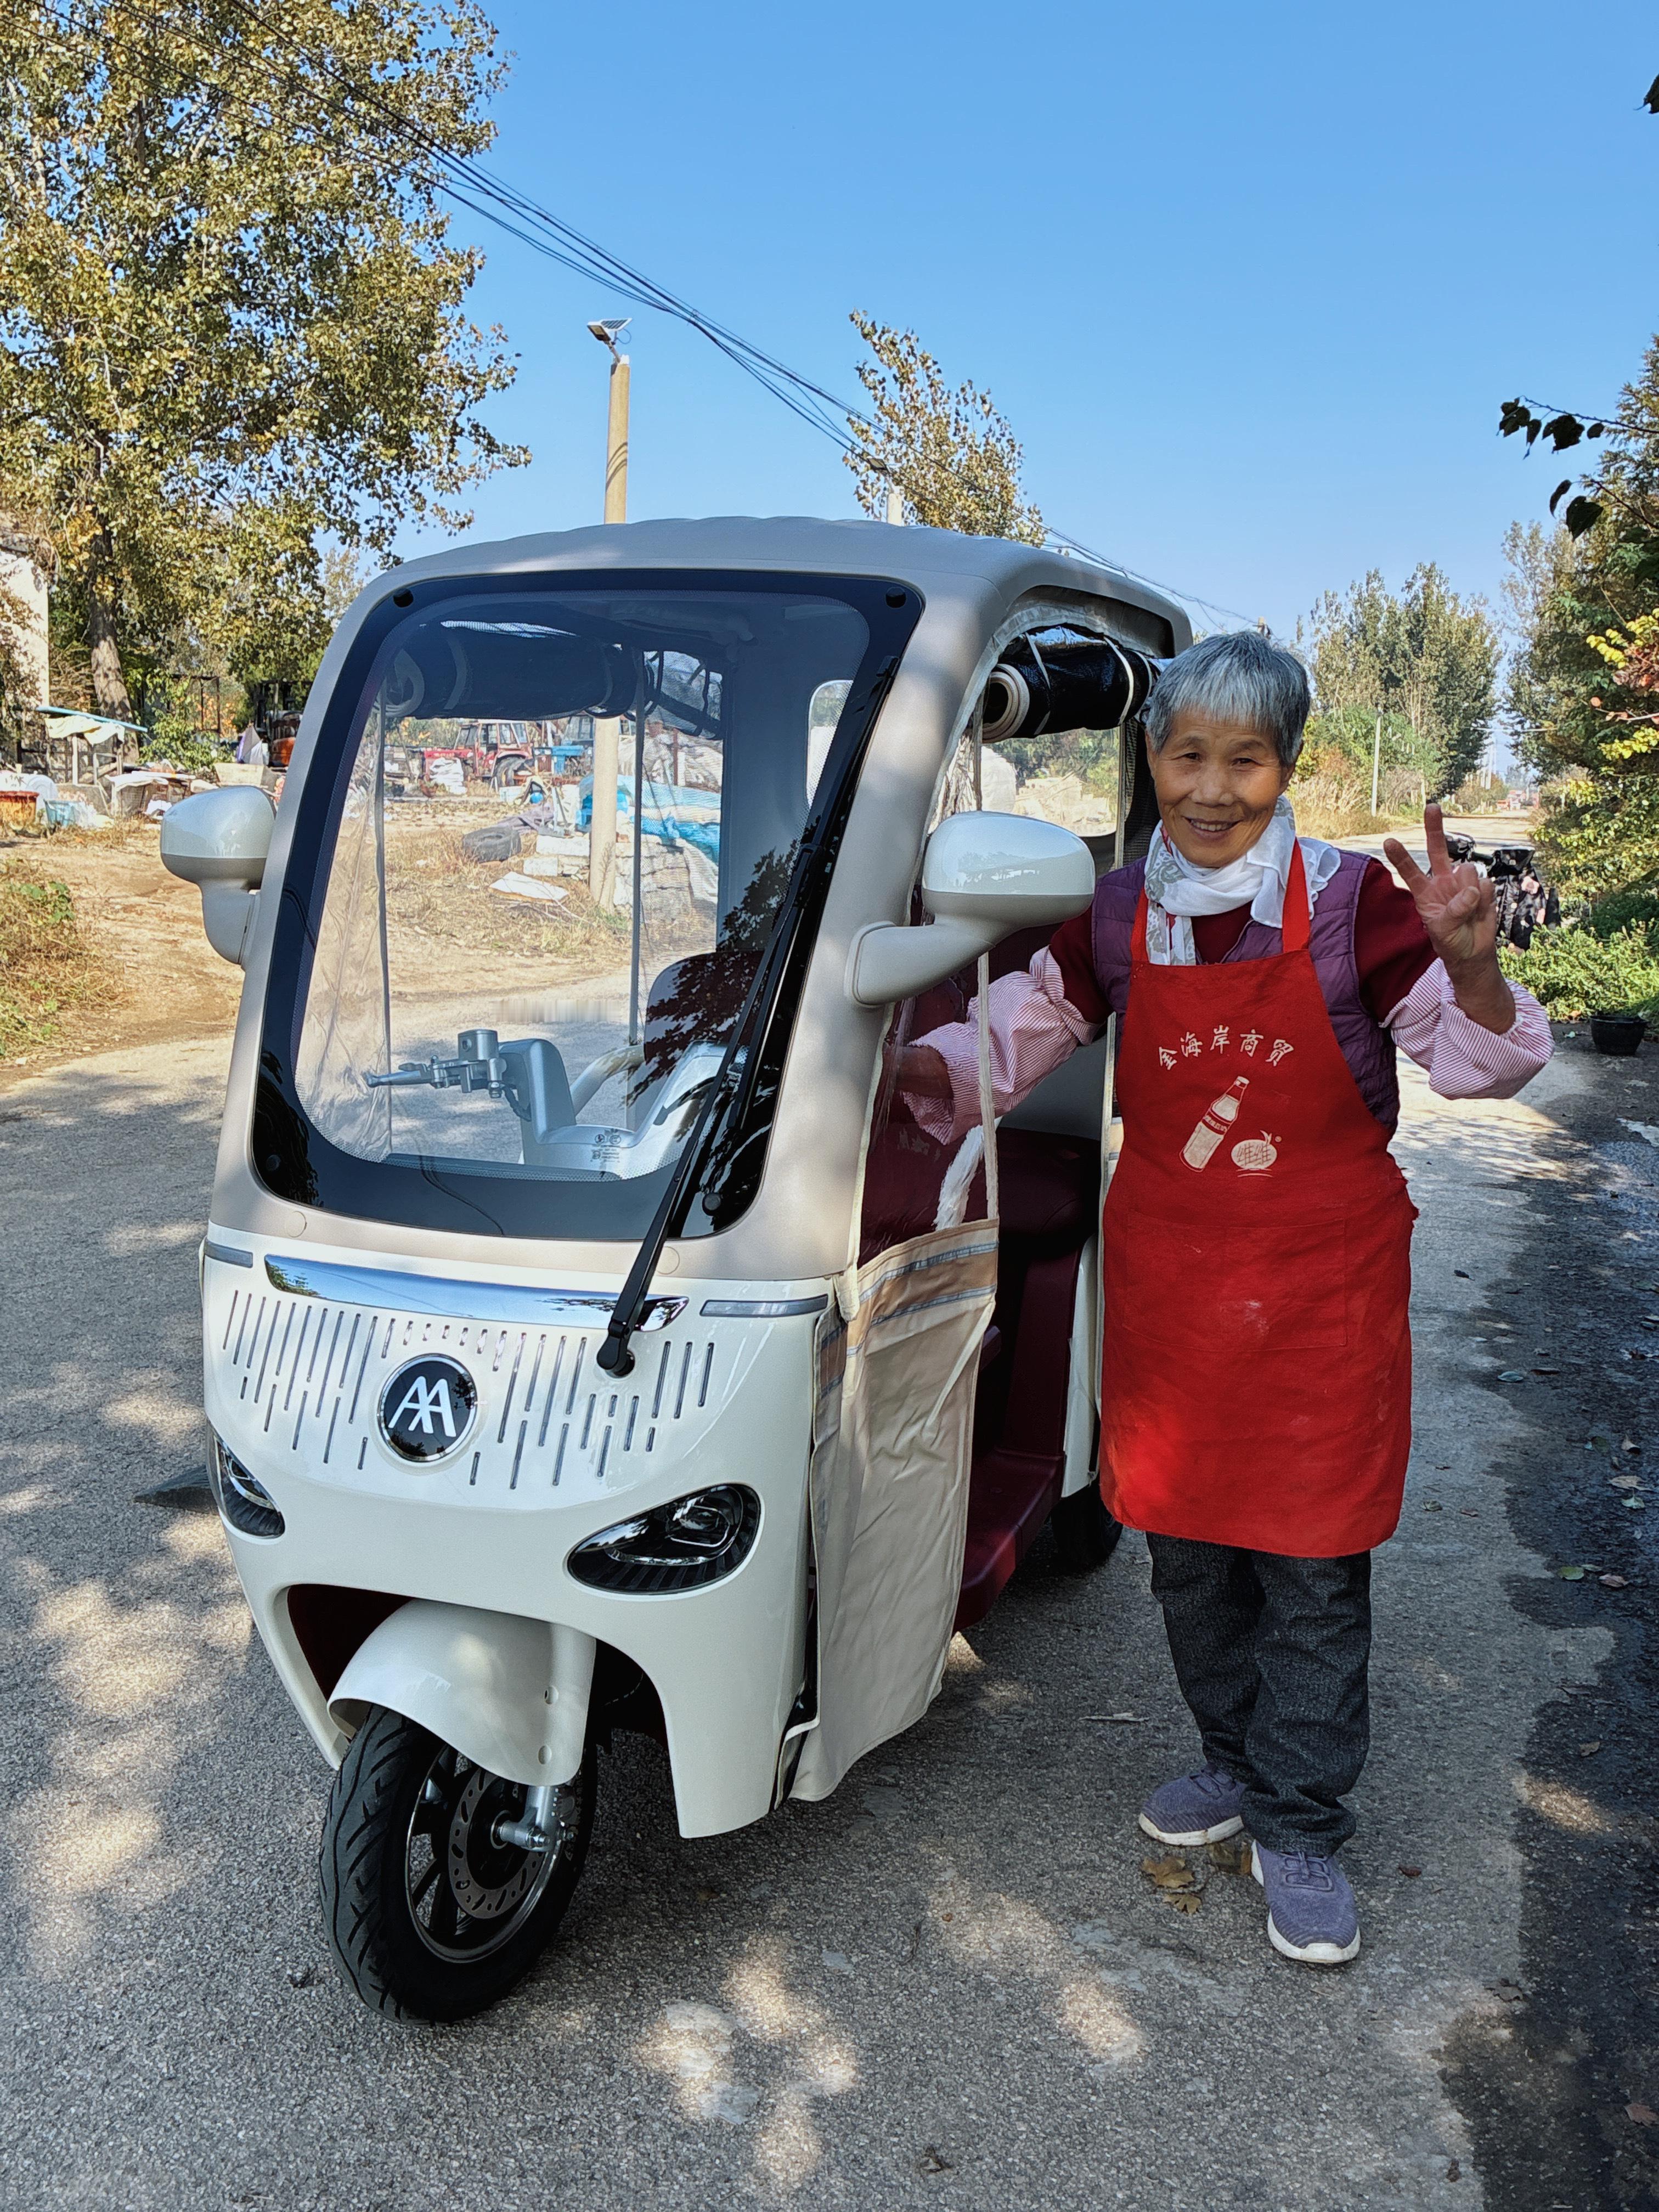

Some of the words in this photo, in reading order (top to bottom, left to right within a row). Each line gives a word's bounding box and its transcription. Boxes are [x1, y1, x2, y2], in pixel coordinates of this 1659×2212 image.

[1159, 1025, 1294, 1070] 金海岸商贸
